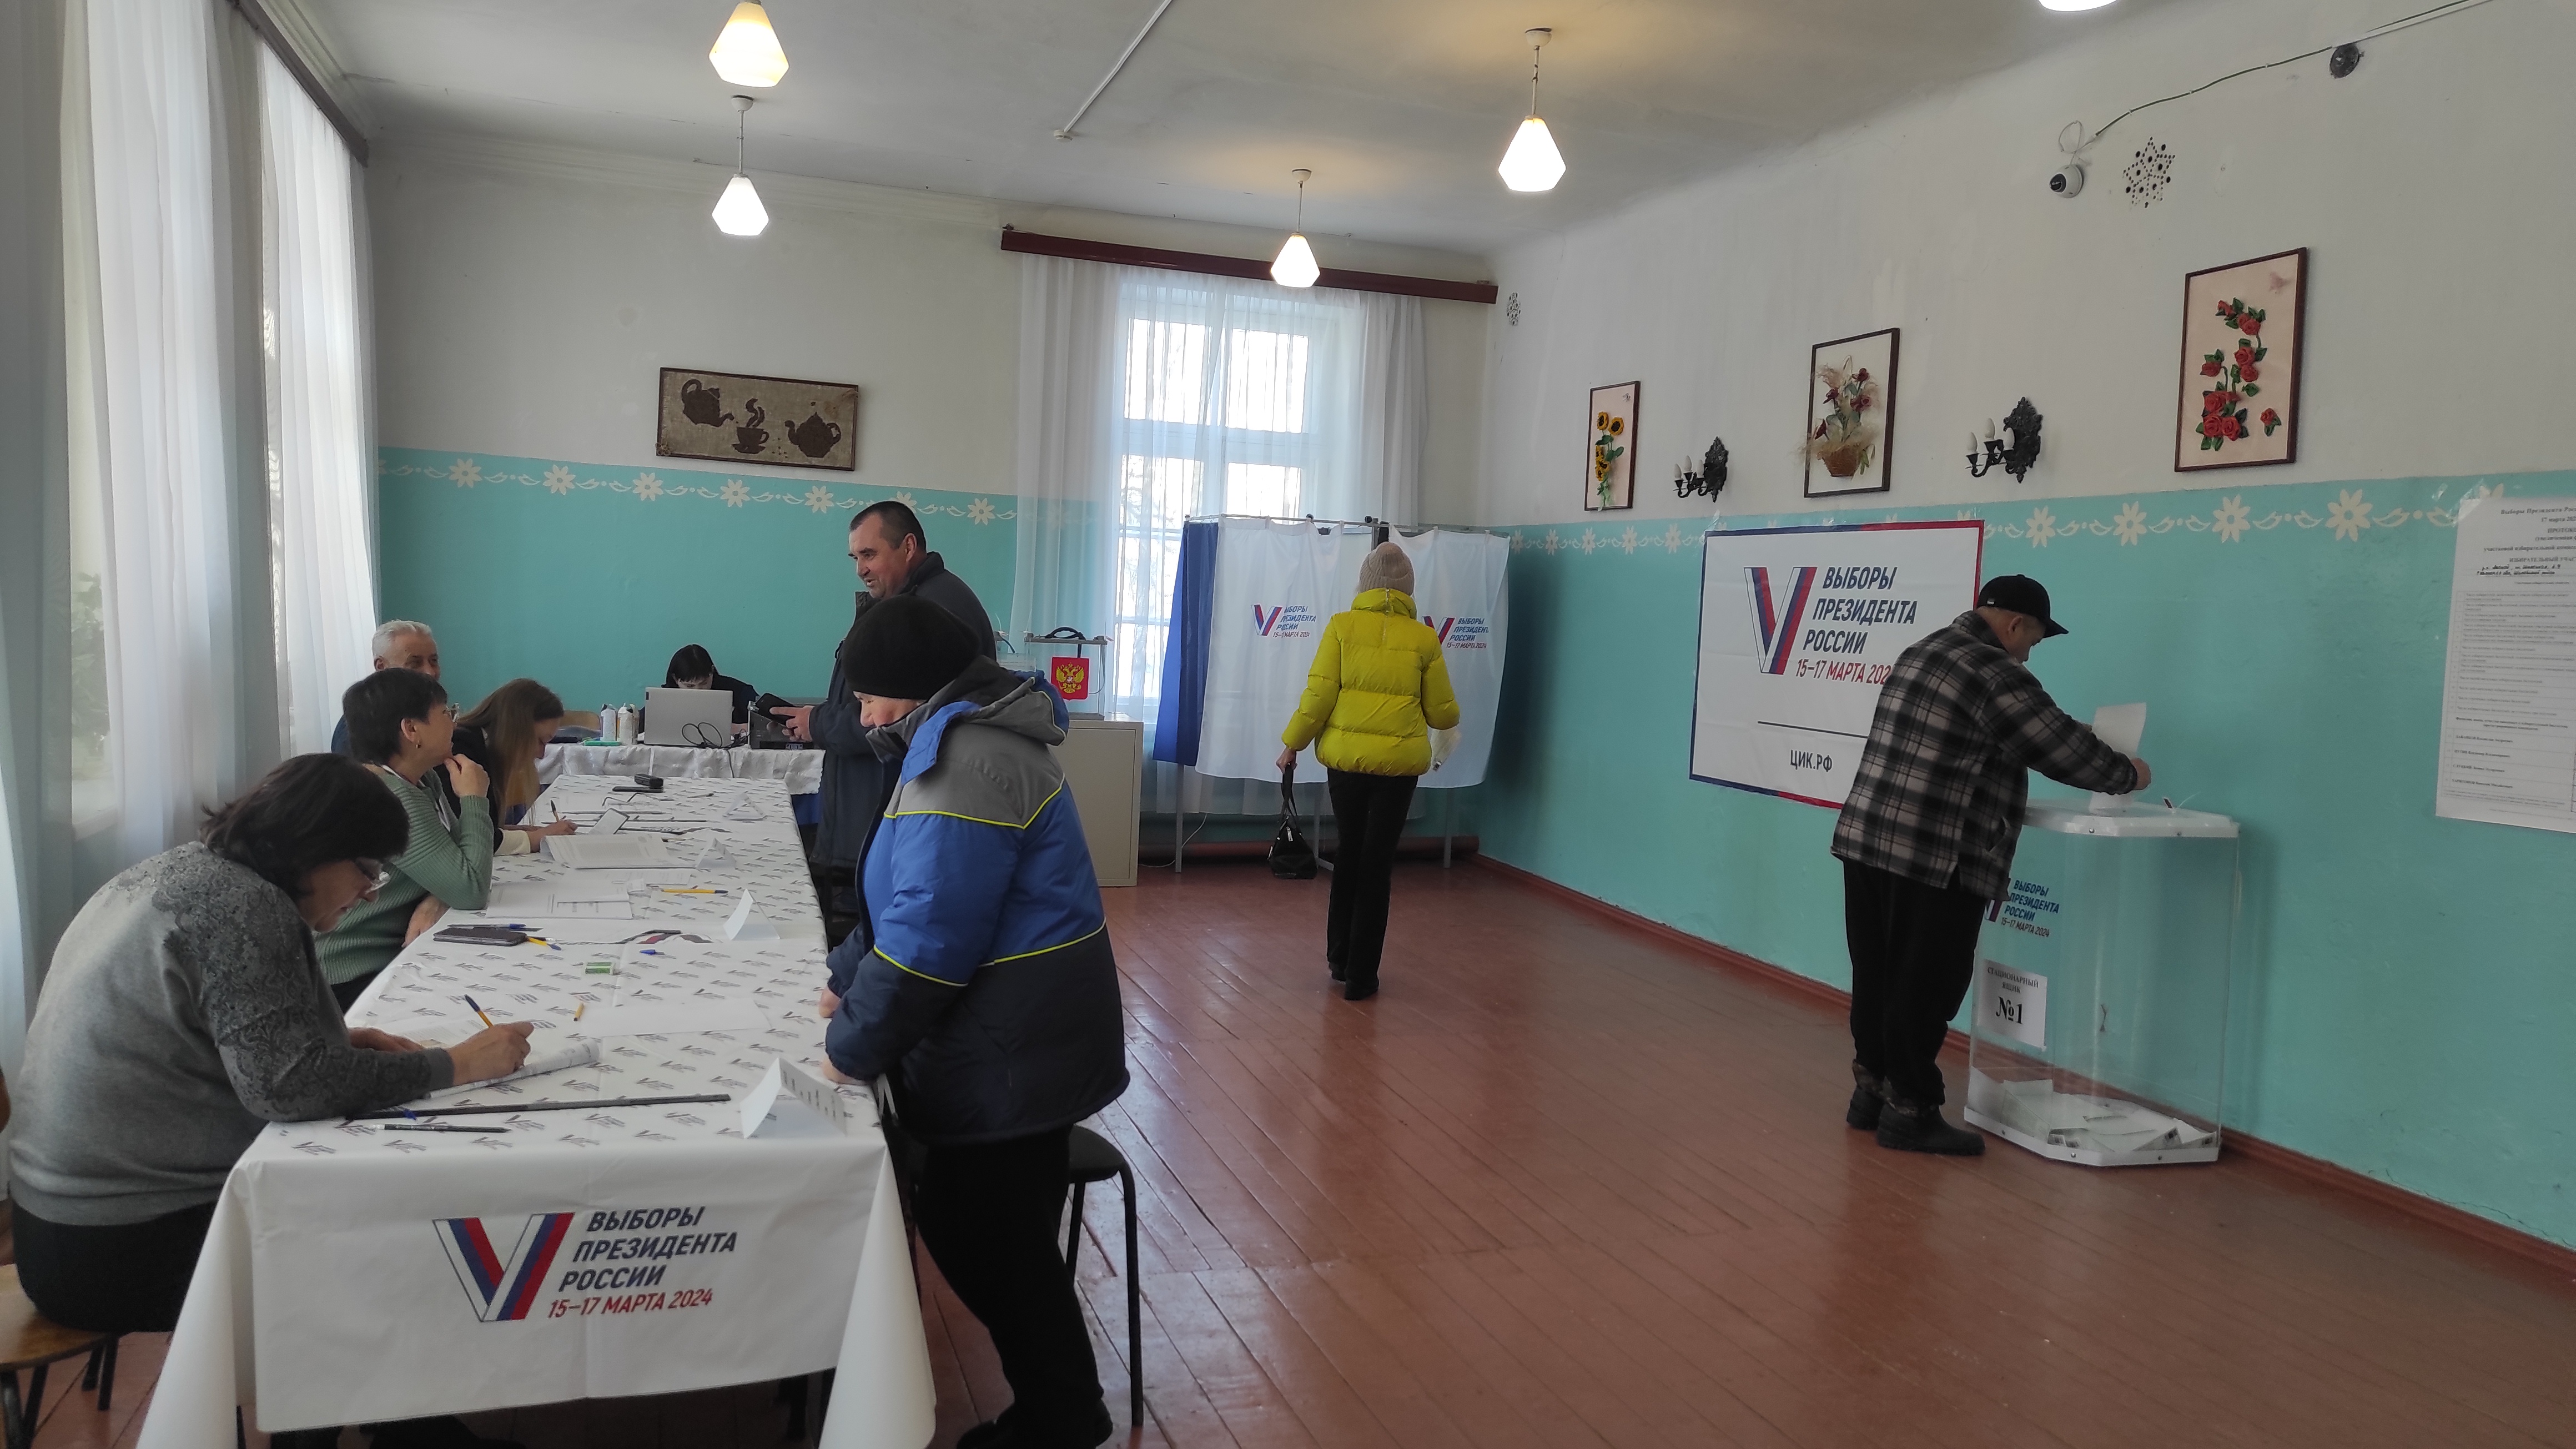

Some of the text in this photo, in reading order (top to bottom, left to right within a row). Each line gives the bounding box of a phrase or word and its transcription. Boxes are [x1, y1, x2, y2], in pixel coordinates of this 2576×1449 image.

[1822, 566, 1898, 590] ВЫБОРЫ
[1812, 597, 1918, 626] ПРЕЗИДЕНТА
[1802, 629, 1868, 655] РОССИИ
[1827, 661, 1865, 684] МАРТА
[1866, 664, 1891, 686] 202
[1790, 749, 1833, 773] ЦИК.РФ
[2013, 879, 2050, 897] ВЫБОРЫ
[2004, 904, 2036, 922] РОССИИ
[2009, 892, 2060, 913] ПРЕЗИДЕНТА
[2015, 920, 2035, 934] МАРТА
[2034, 926, 2050, 937] 2024
[1987, 967, 2039, 988] СТАЦИОНАРНЫЙ
[2002, 982, 2021, 994] ЯЩИК
[586, 1206, 706, 1233] ВЫБОРЫ
[572, 1231, 738, 1263] ПРЕЗИДЕНТА
[558, 1264, 666, 1292] РОССИИ
[601, 1292, 666, 1315] МАРТА
[667, 1288, 713, 1310] 2024
